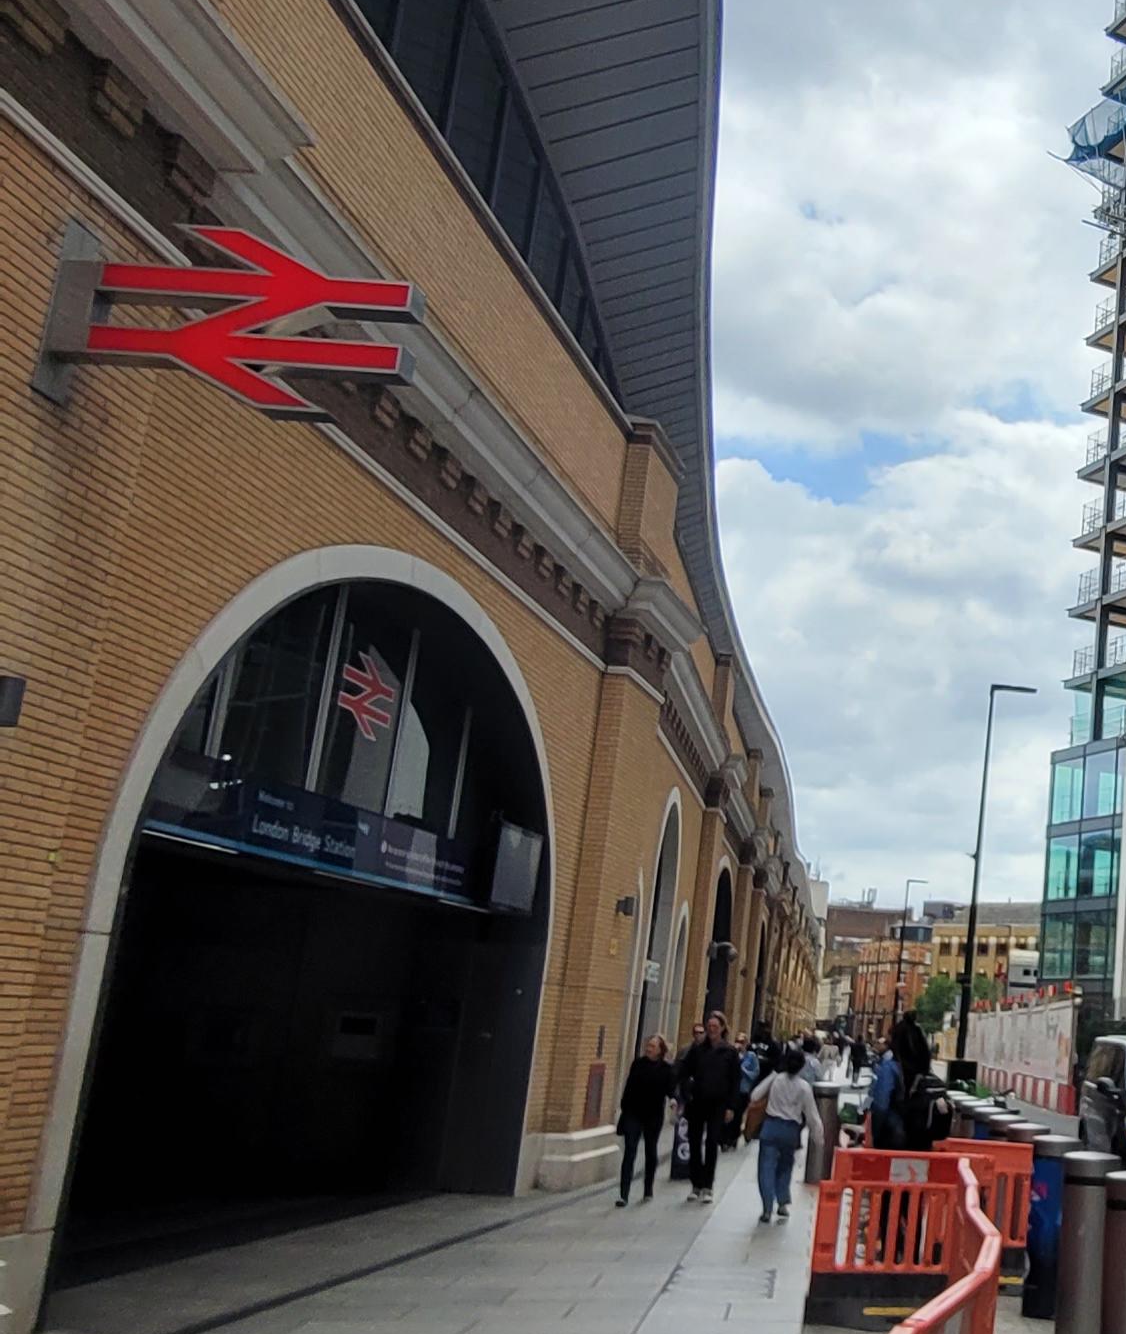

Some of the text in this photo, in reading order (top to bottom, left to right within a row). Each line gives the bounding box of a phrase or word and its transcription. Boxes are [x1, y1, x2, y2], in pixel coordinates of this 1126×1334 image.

[252, 813, 289, 841] London
[291, 825, 321, 853] Bridge
[323, 834, 356, 859] Station
